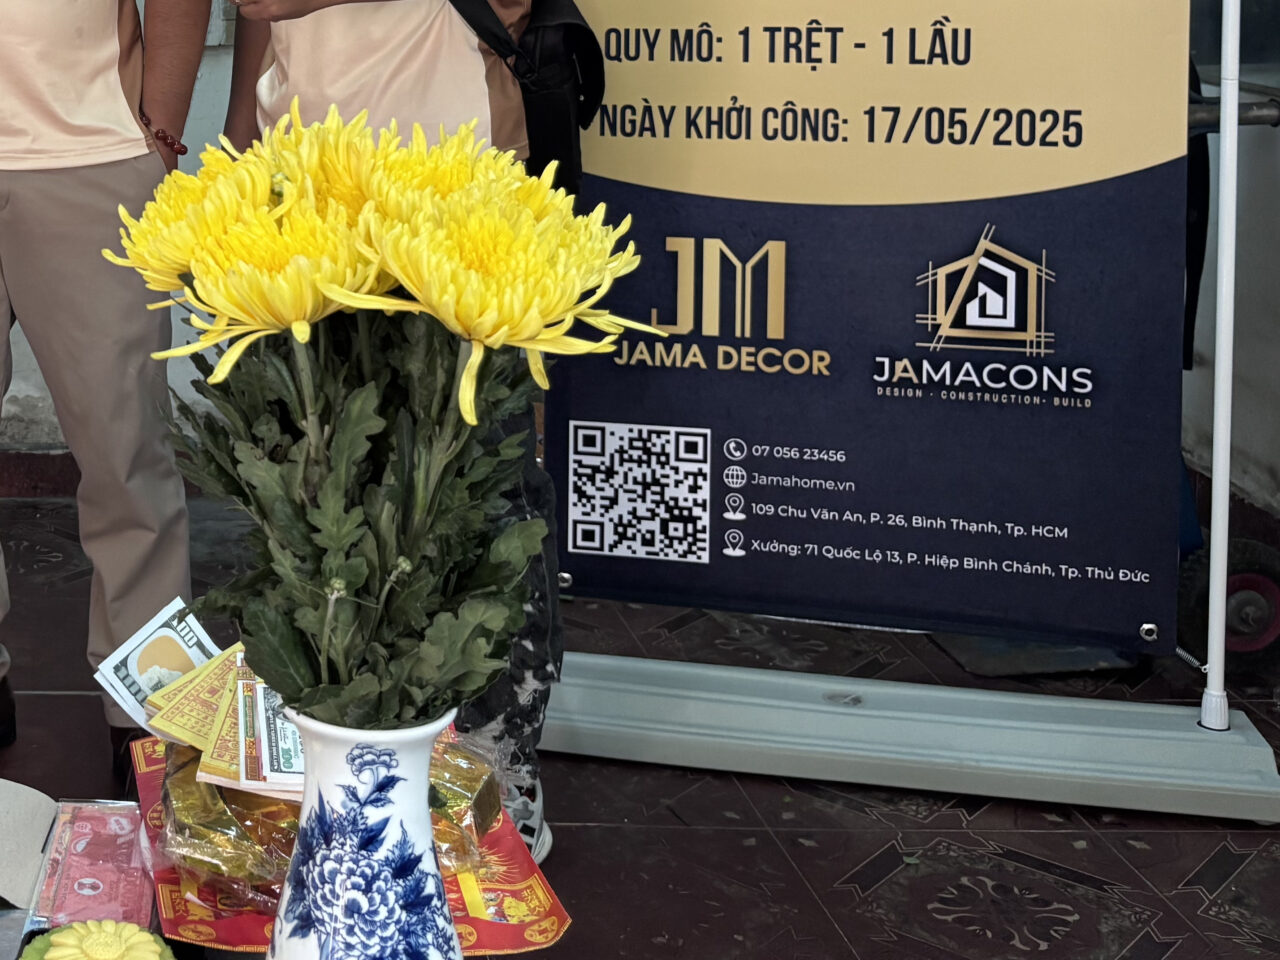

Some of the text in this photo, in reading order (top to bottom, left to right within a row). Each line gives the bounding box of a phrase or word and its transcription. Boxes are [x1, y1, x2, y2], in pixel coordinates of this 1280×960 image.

[603, 27, 662, 62] QUY
[669, 22, 723, 63] MÔ:
[737, 26, 750, 64] 1
[762, 19, 844, 71] TRỆT
[882, 27, 894, 65] 1
[908, 16, 972, 66] LẦU
[599, 95, 1083, 148] NGÀY KHỞI CÔNG: 17/05/2025
[650, 236, 786, 339] JM
[614, 340, 831, 376] JAMA DECOR
[872, 356, 1093, 394] JAMACONS
[876, 386, 922, 398] DESIGN
[1053, 396, 1092, 408] BUILD
[752, 445, 846, 462] 07 056 23456
[751, 472, 855, 492] Jamahome.vn
[751, 503, 1069, 539] 109 Chu Văn An, P. 26, Bình Thạnh, Tp. HCM
[751, 539, 1151, 583] Xưởng: 71 Quốc Lộ 13, P. Hiệp Bình Chánh, Tp. Thủ Đức
[281, 747, 294, 770] 100
